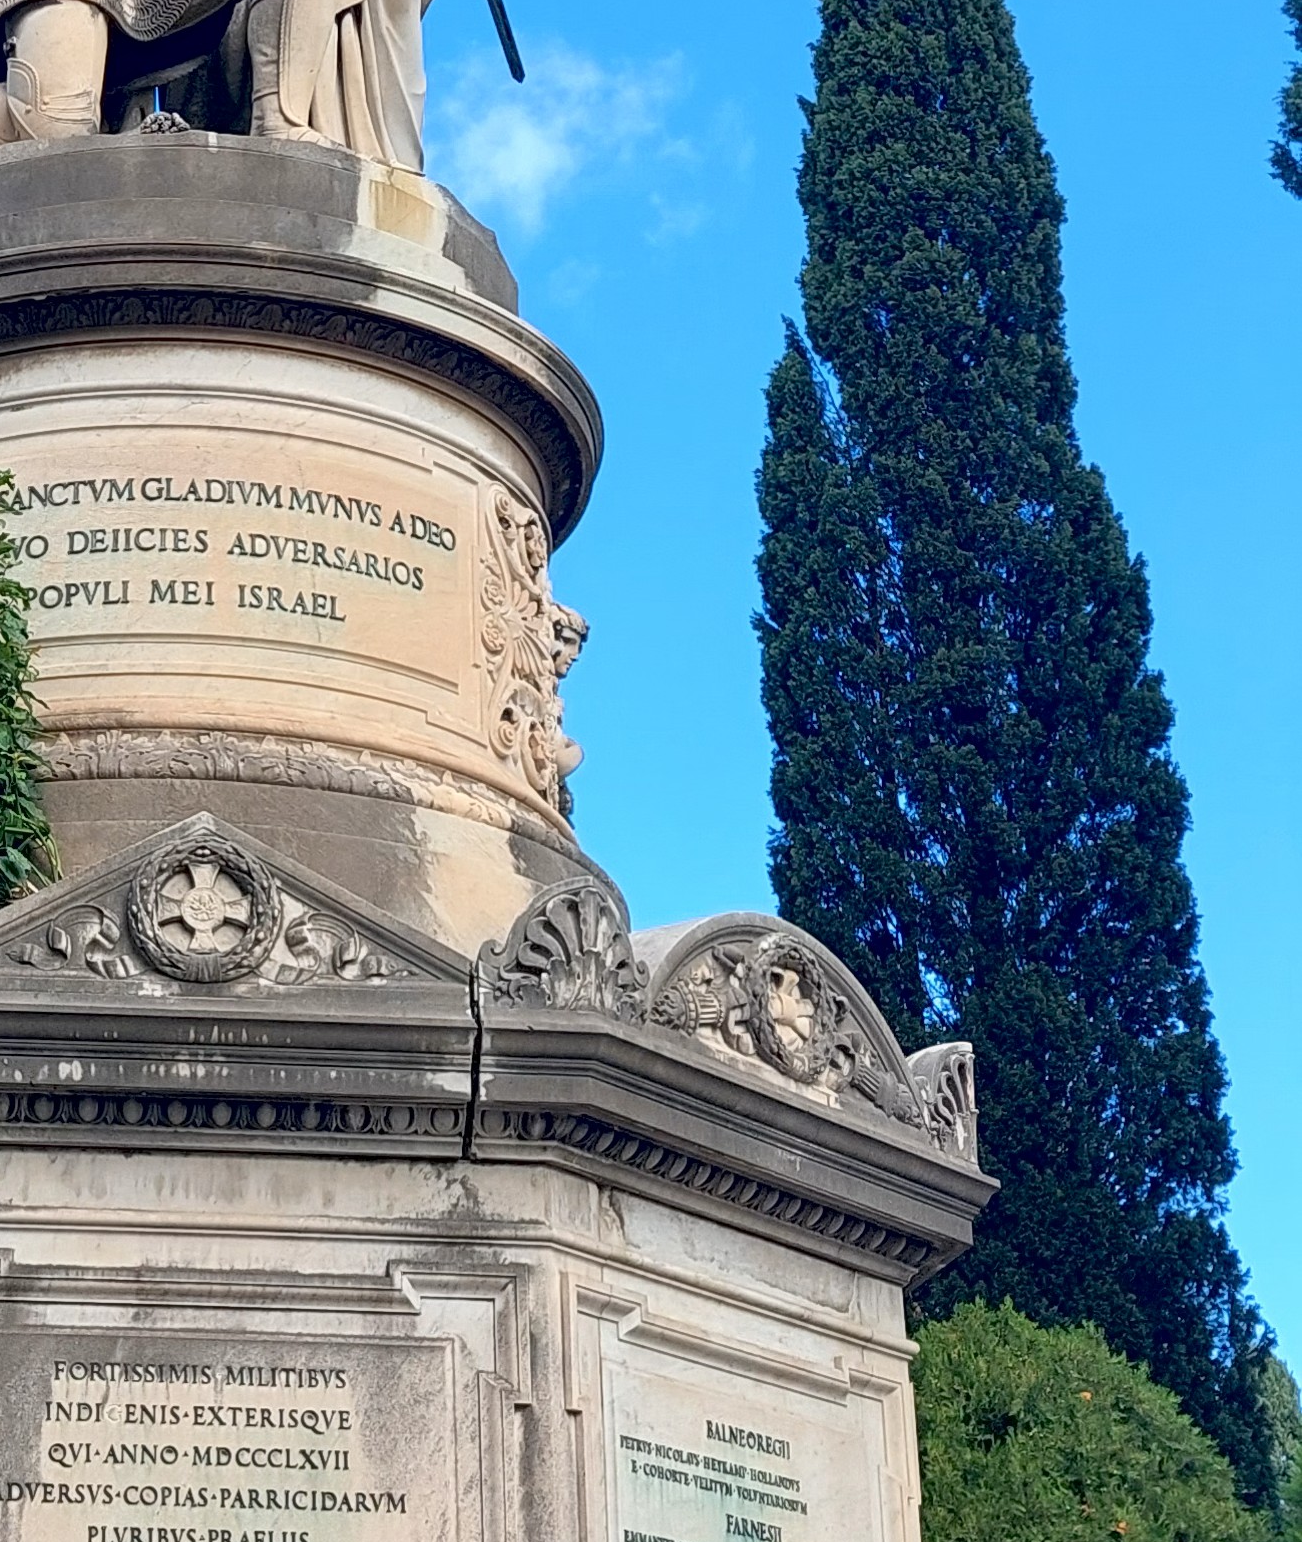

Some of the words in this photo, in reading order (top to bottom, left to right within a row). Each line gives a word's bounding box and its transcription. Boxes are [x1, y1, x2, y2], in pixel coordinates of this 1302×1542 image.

[139, 477, 283, 509] GLADIVM
[288, 487, 383, 528] MVNVS
[389, 509, 407, 535] A
[409, 516, 457, 552] DEO
[6, 534, 50, 559] VO
[68, 529, 208, 556] DEIICIES
[227, 532, 425, 592] ADVERSARIOS
[148, 580, 215, 606] MEI
[238, 584, 347, 623] ISRAEL
[53, 1360, 211, 1385] FORTISSIMIS
[225, 1364, 347, 1389] MILITIBVS
[192, 1405, 351, 1435] EXTERISQVE
[48, 1442, 91, 1468] QVI
[103, 1444, 179, 1467] ANNO
[191, 1446, 350, 1471] MDCCCLXVII
[122, 1485, 208, 1508] COPIAS
[219, 1488, 407, 1514] PARRICIDARVM
